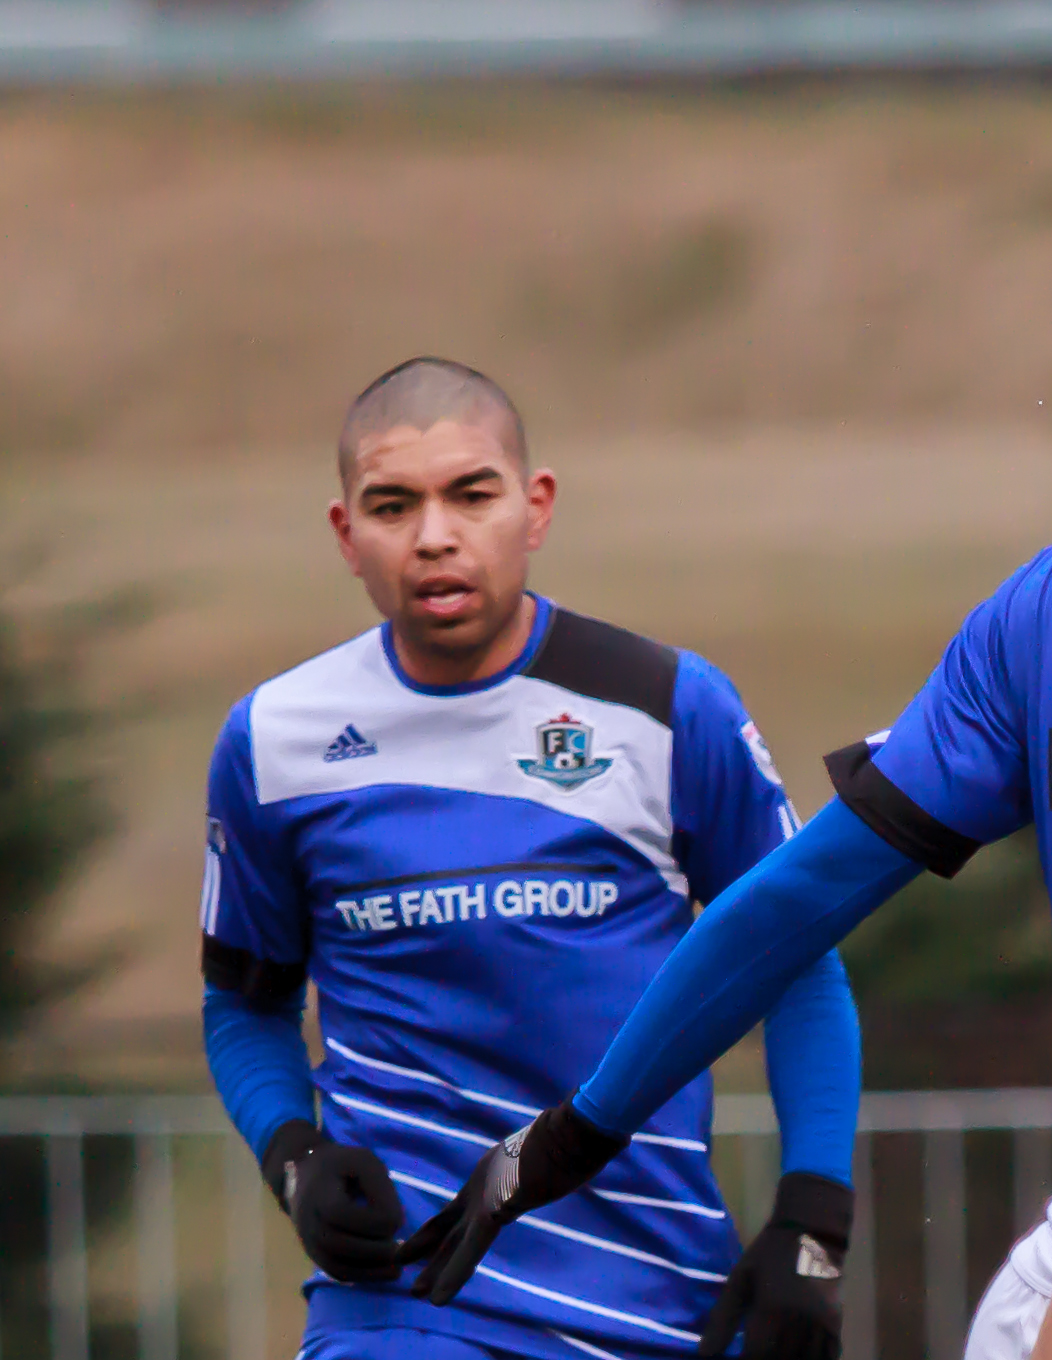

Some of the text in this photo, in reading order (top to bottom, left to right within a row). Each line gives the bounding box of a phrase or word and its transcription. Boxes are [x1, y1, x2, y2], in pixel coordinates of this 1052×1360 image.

[335, 879, 619, 931] THE FATH GROUP
